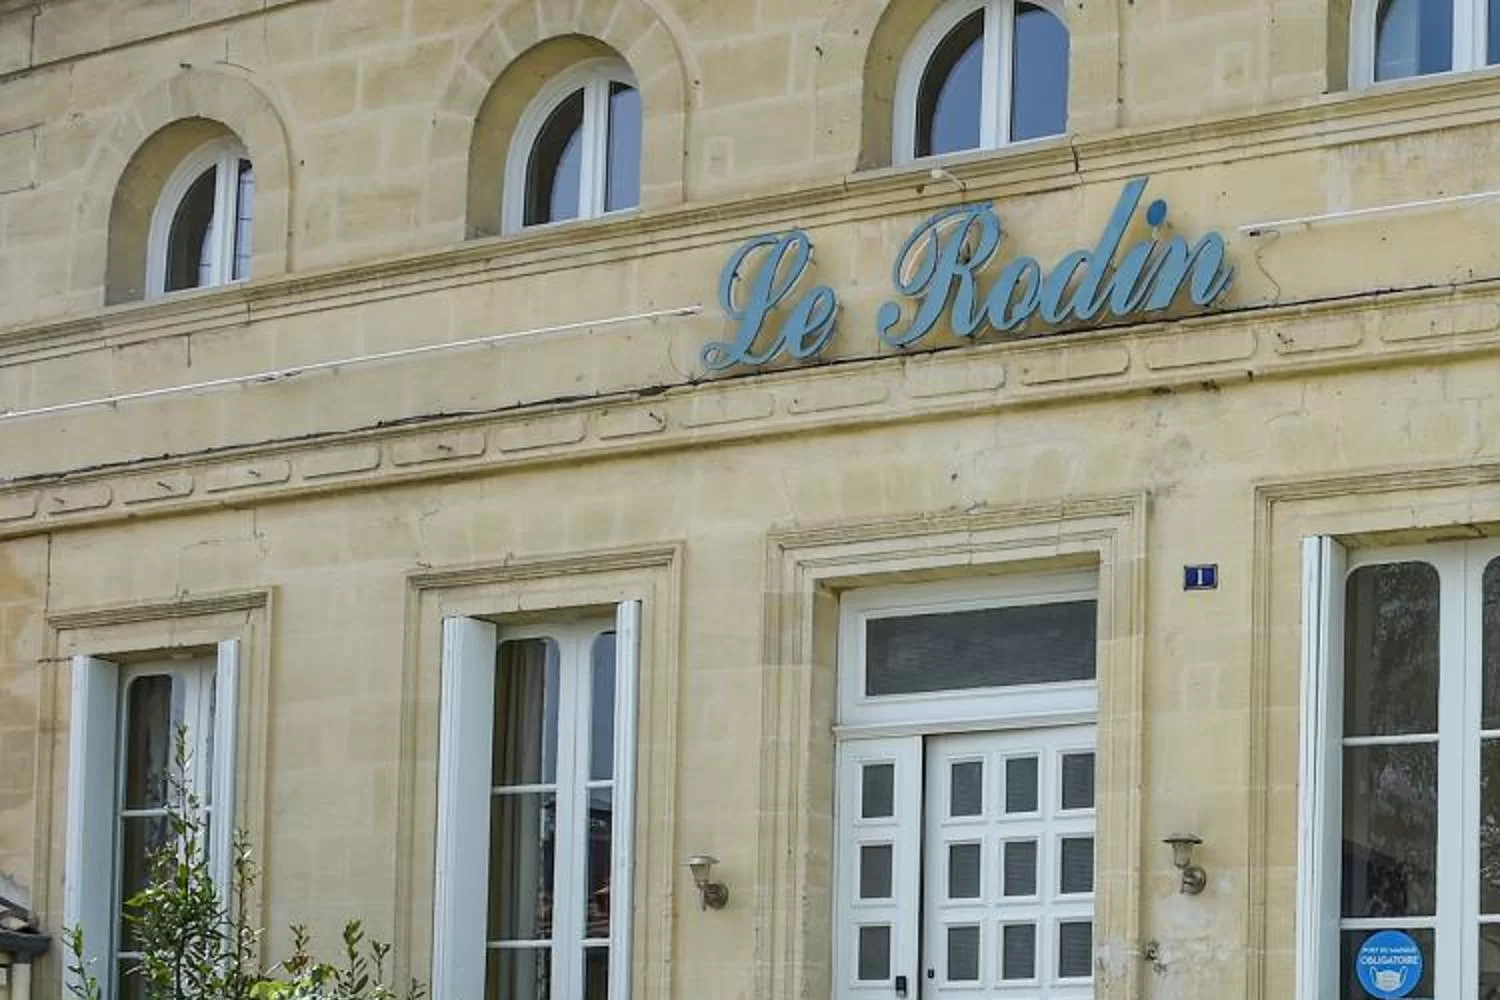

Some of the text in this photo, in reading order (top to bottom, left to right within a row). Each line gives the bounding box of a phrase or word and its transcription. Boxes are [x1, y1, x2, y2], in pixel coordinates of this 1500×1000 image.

[703, 176, 1236, 370] Le Rodin
[1360, 955, 1419, 965] OBLIGATOIRE
